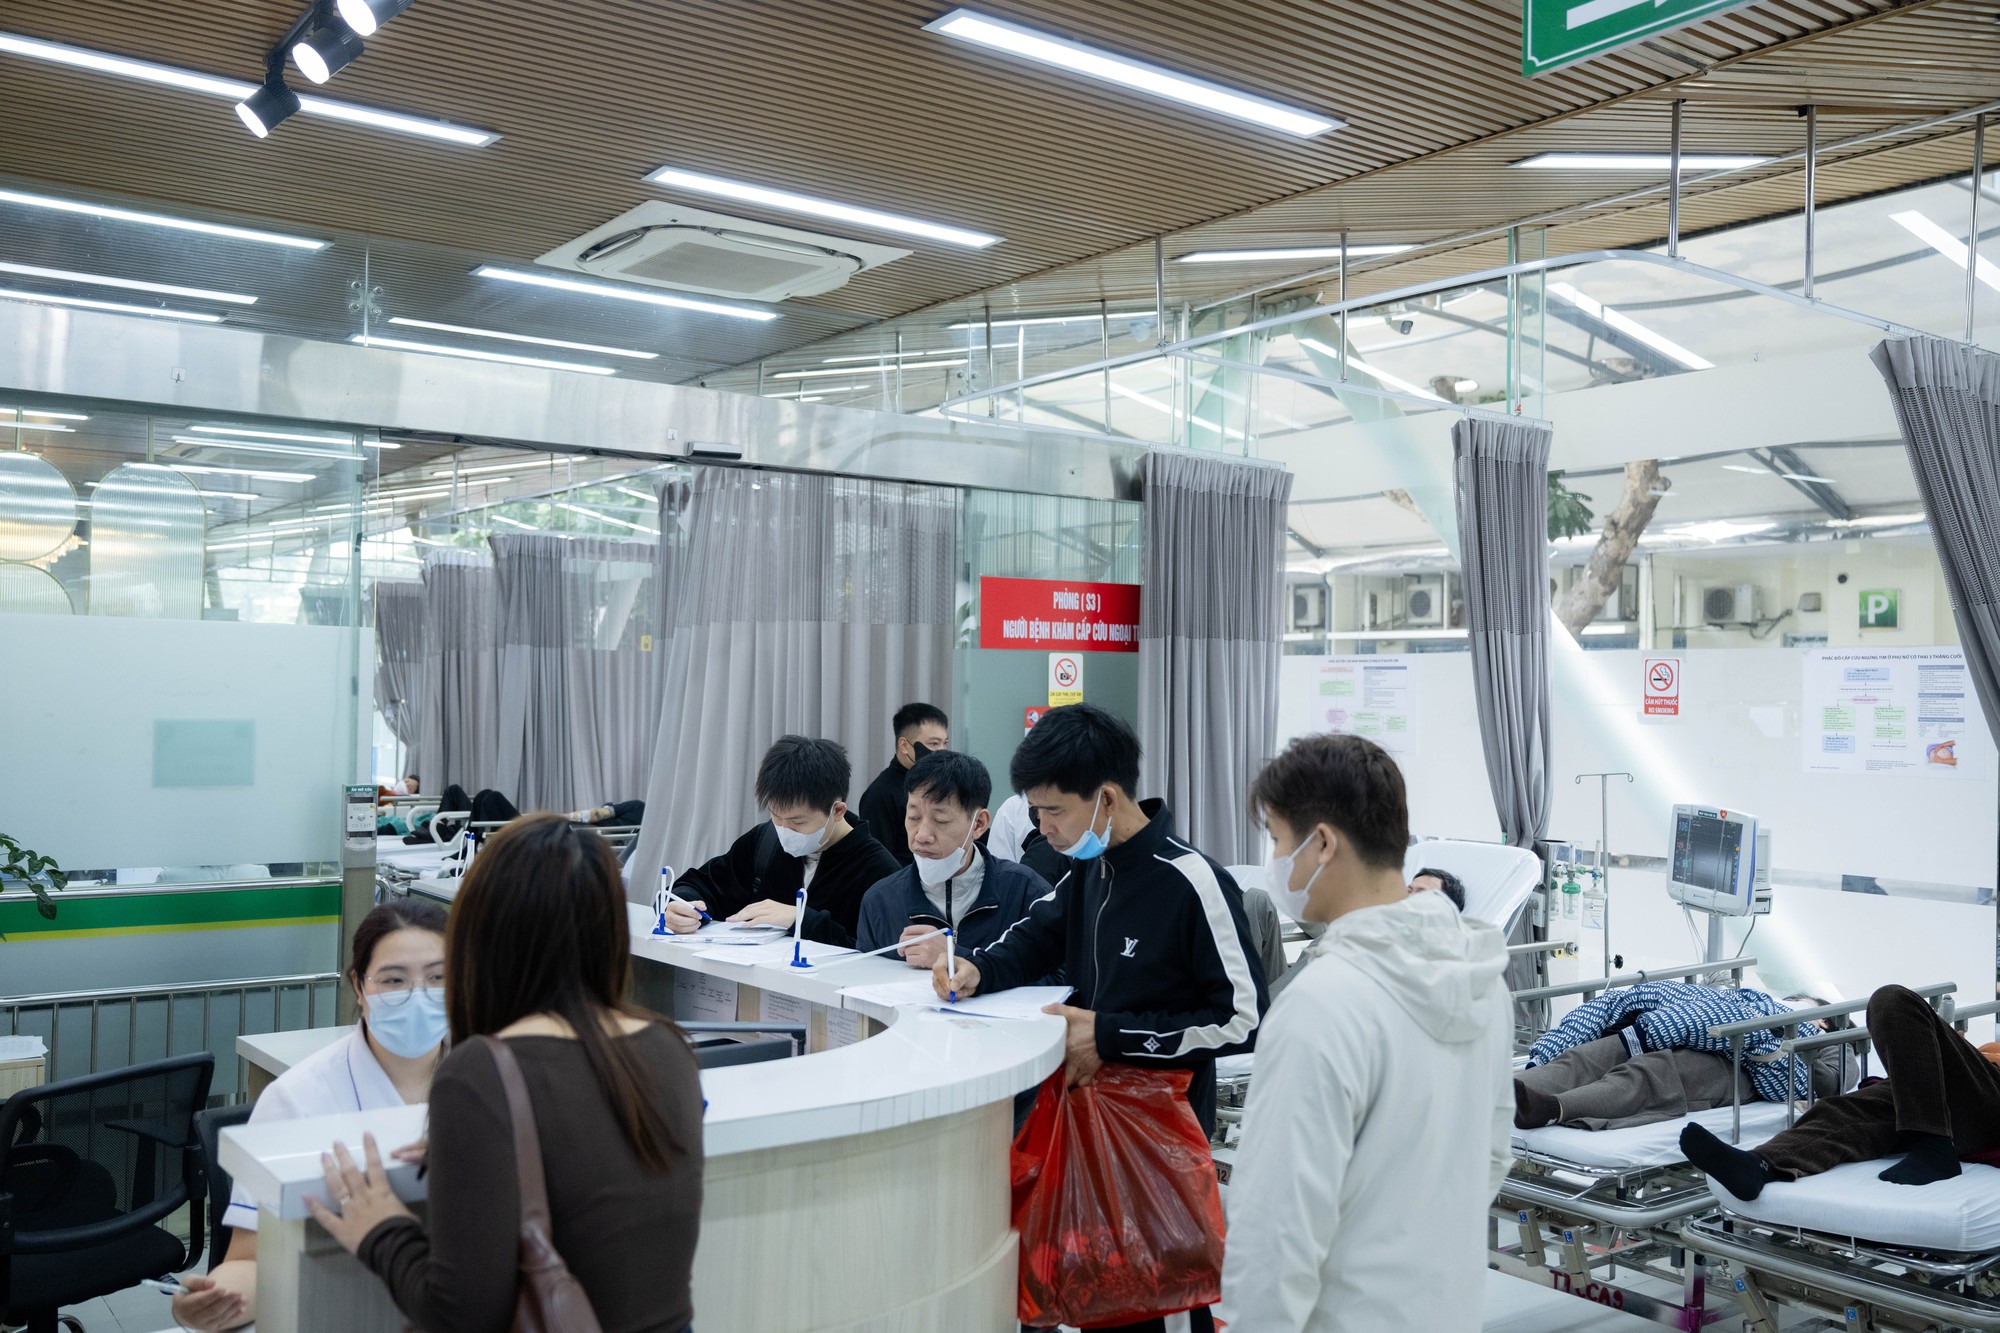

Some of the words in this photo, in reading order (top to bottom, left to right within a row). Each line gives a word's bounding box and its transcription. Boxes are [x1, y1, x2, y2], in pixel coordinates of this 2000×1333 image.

[1053, 588, 1079, 610] PHÒNG
[1867, 594, 1889, 624] P
[1003, 616, 1027, 639] NGƯỜI
[1029, 617, 1050, 643] BỆNH
[1052, 618, 1074, 640] KHÁM
[1076, 616, 1091, 641] CẤP
[1092, 619, 1108, 642] CỨU
[1109, 624, 1130, 646] NGOẠI
